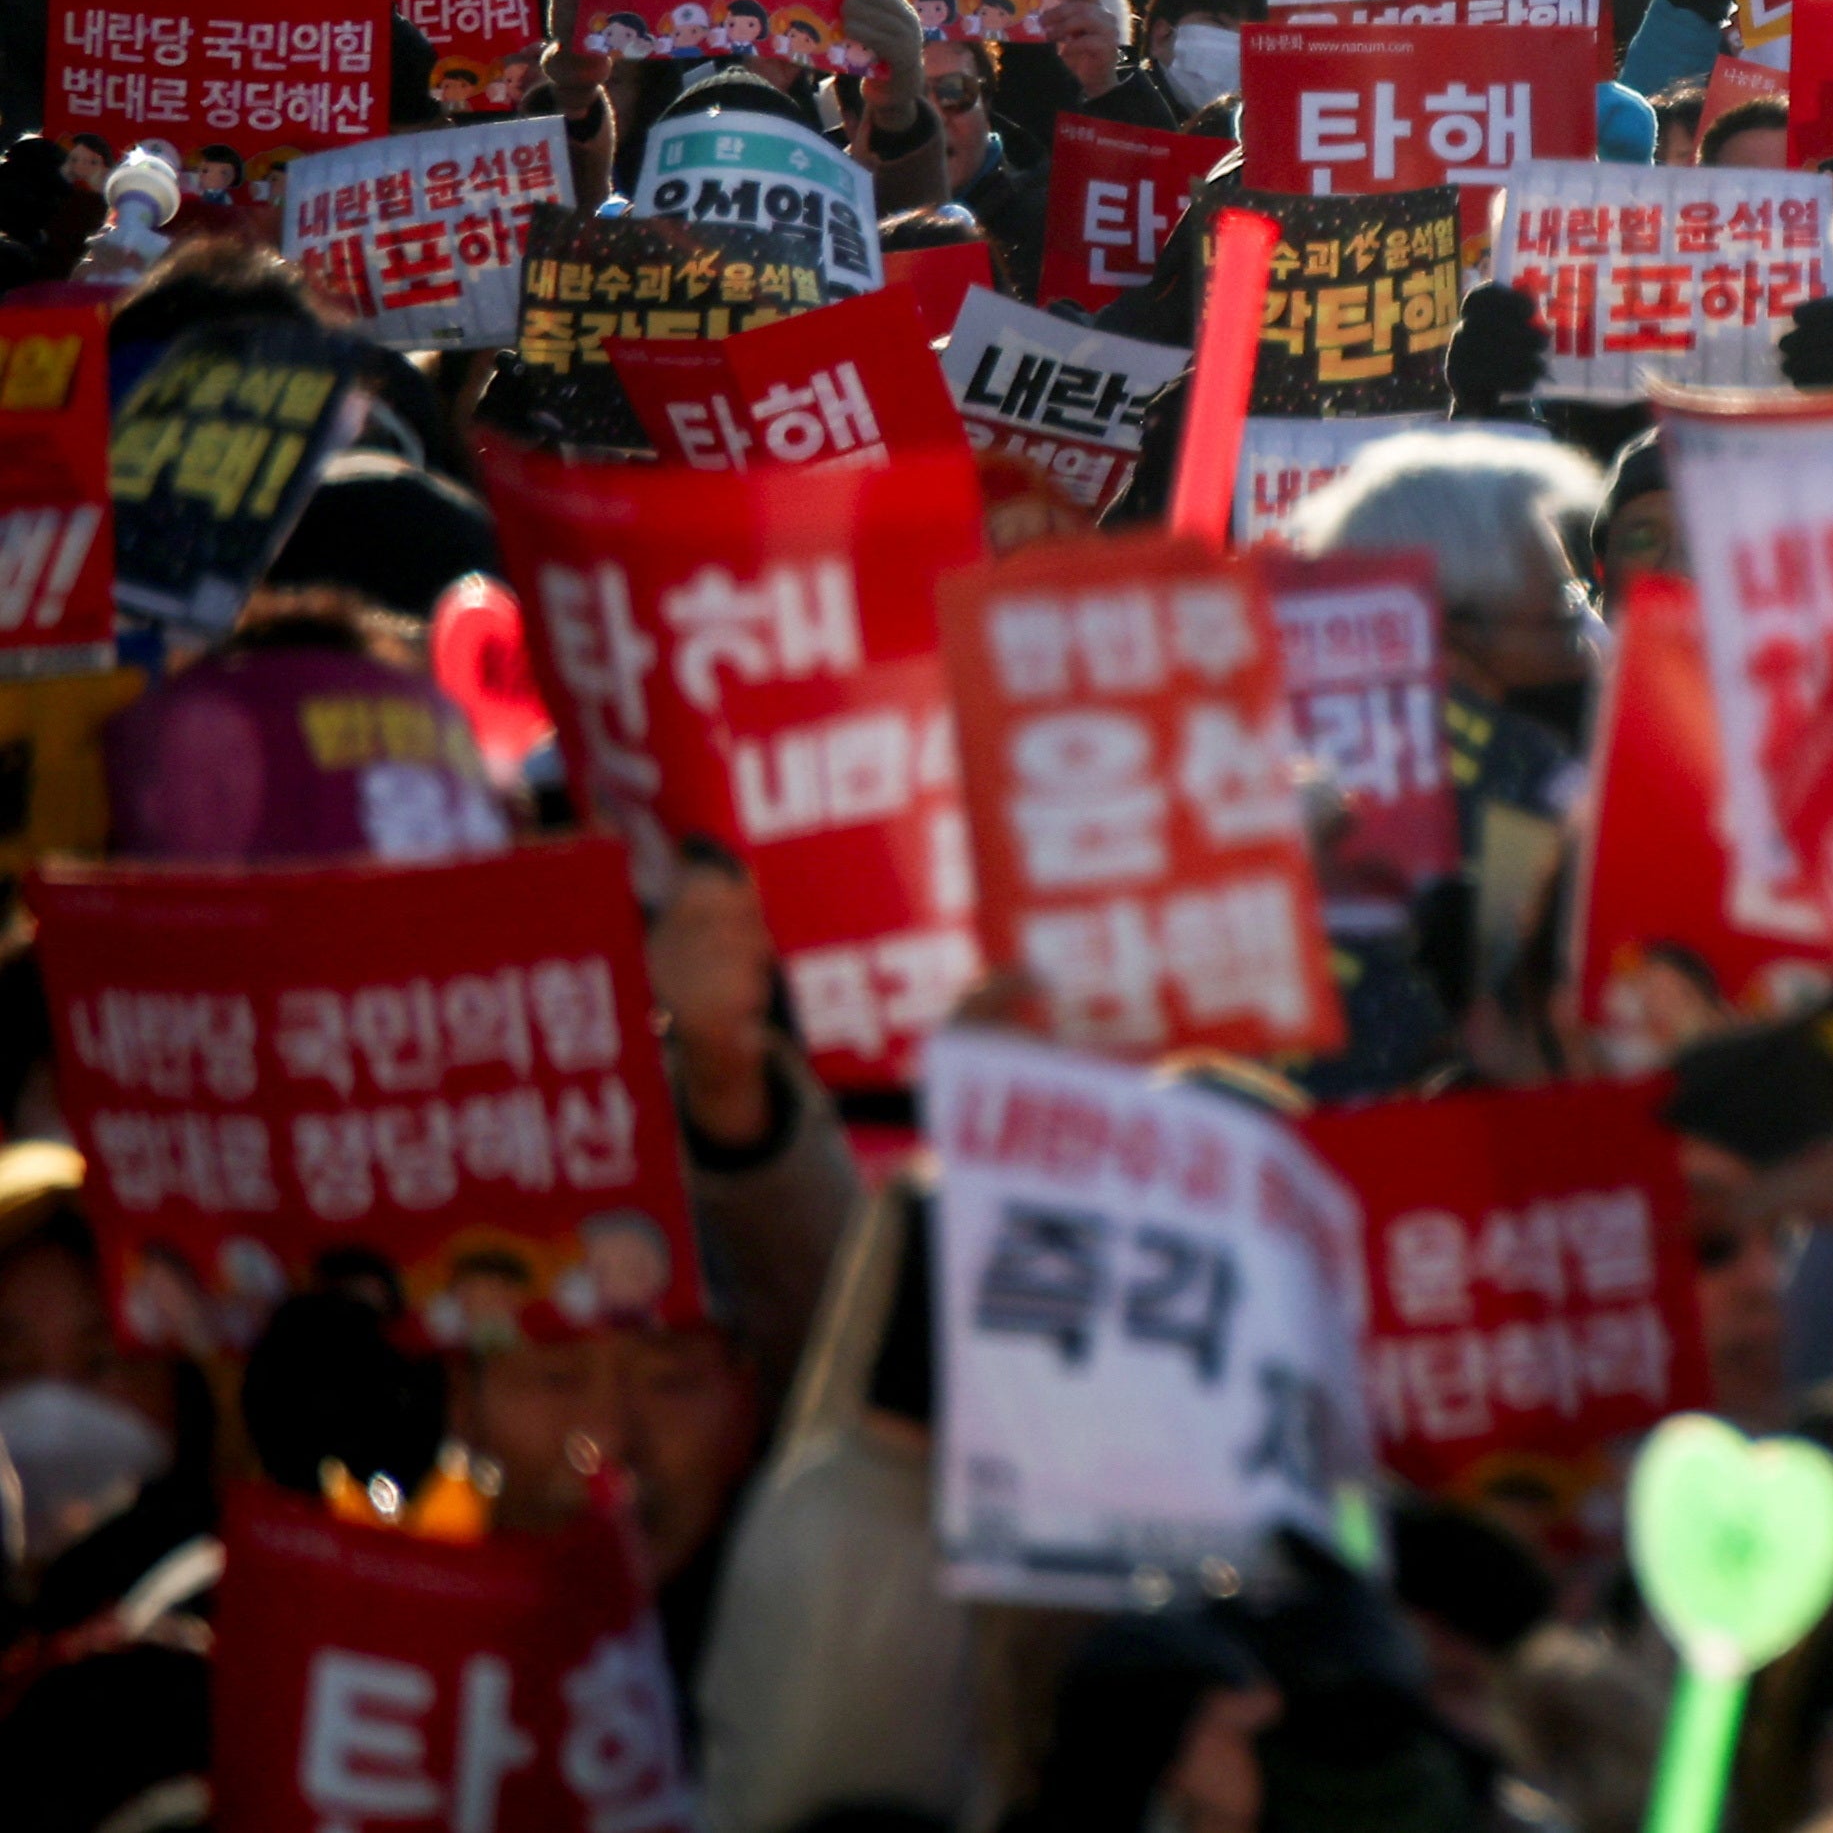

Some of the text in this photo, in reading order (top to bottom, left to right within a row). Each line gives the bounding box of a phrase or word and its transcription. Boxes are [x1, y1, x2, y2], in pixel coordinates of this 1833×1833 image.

[62, 8, 374, 74] 내란당 국민의힘
[60, 67, 375, 136] 법대로 정당해산
[1298, 80, 1535, 196] 탄핵
[297, 139, 556, 239] 내란범 윤석열
[1517, 197, 1822, 258] 내란범 윤석열
[526, 256, 824, 308] 내란수괴 윤석열
[1312, 269, 1462, 385] 탄핵
[666, 357, 892, 477] 탄핵
